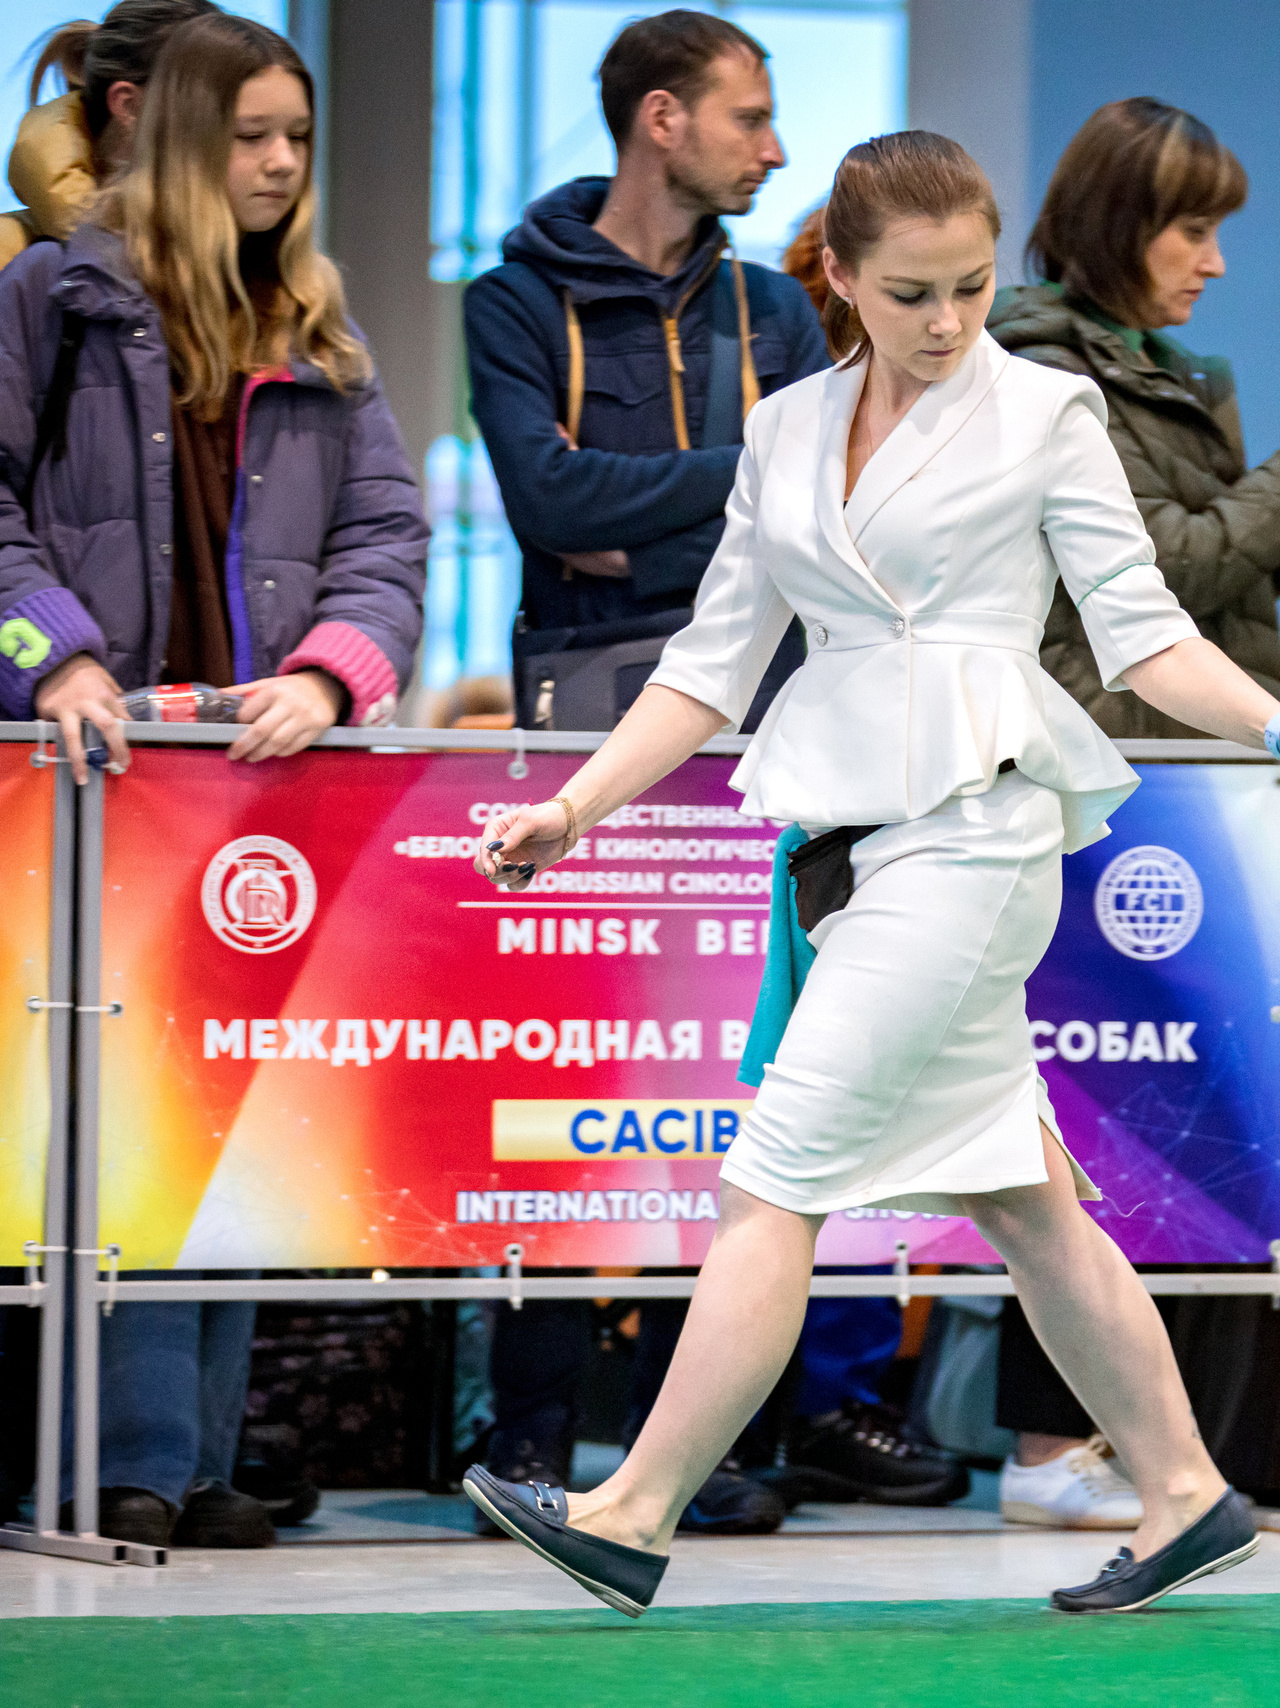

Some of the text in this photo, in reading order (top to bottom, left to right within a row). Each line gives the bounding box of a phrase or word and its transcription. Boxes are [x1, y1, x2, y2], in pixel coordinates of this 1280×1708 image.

[497, 918, 661, 955] MINSK
[204, 1019, 701, 1066] МЕЖДУНАРОДНАЯ
[1029, 1020, 1198, 1062] СОБАК
[570, 1109, 738, 1153] CACIB
[457, 1189, 719, 1221] INTERNATIONA
